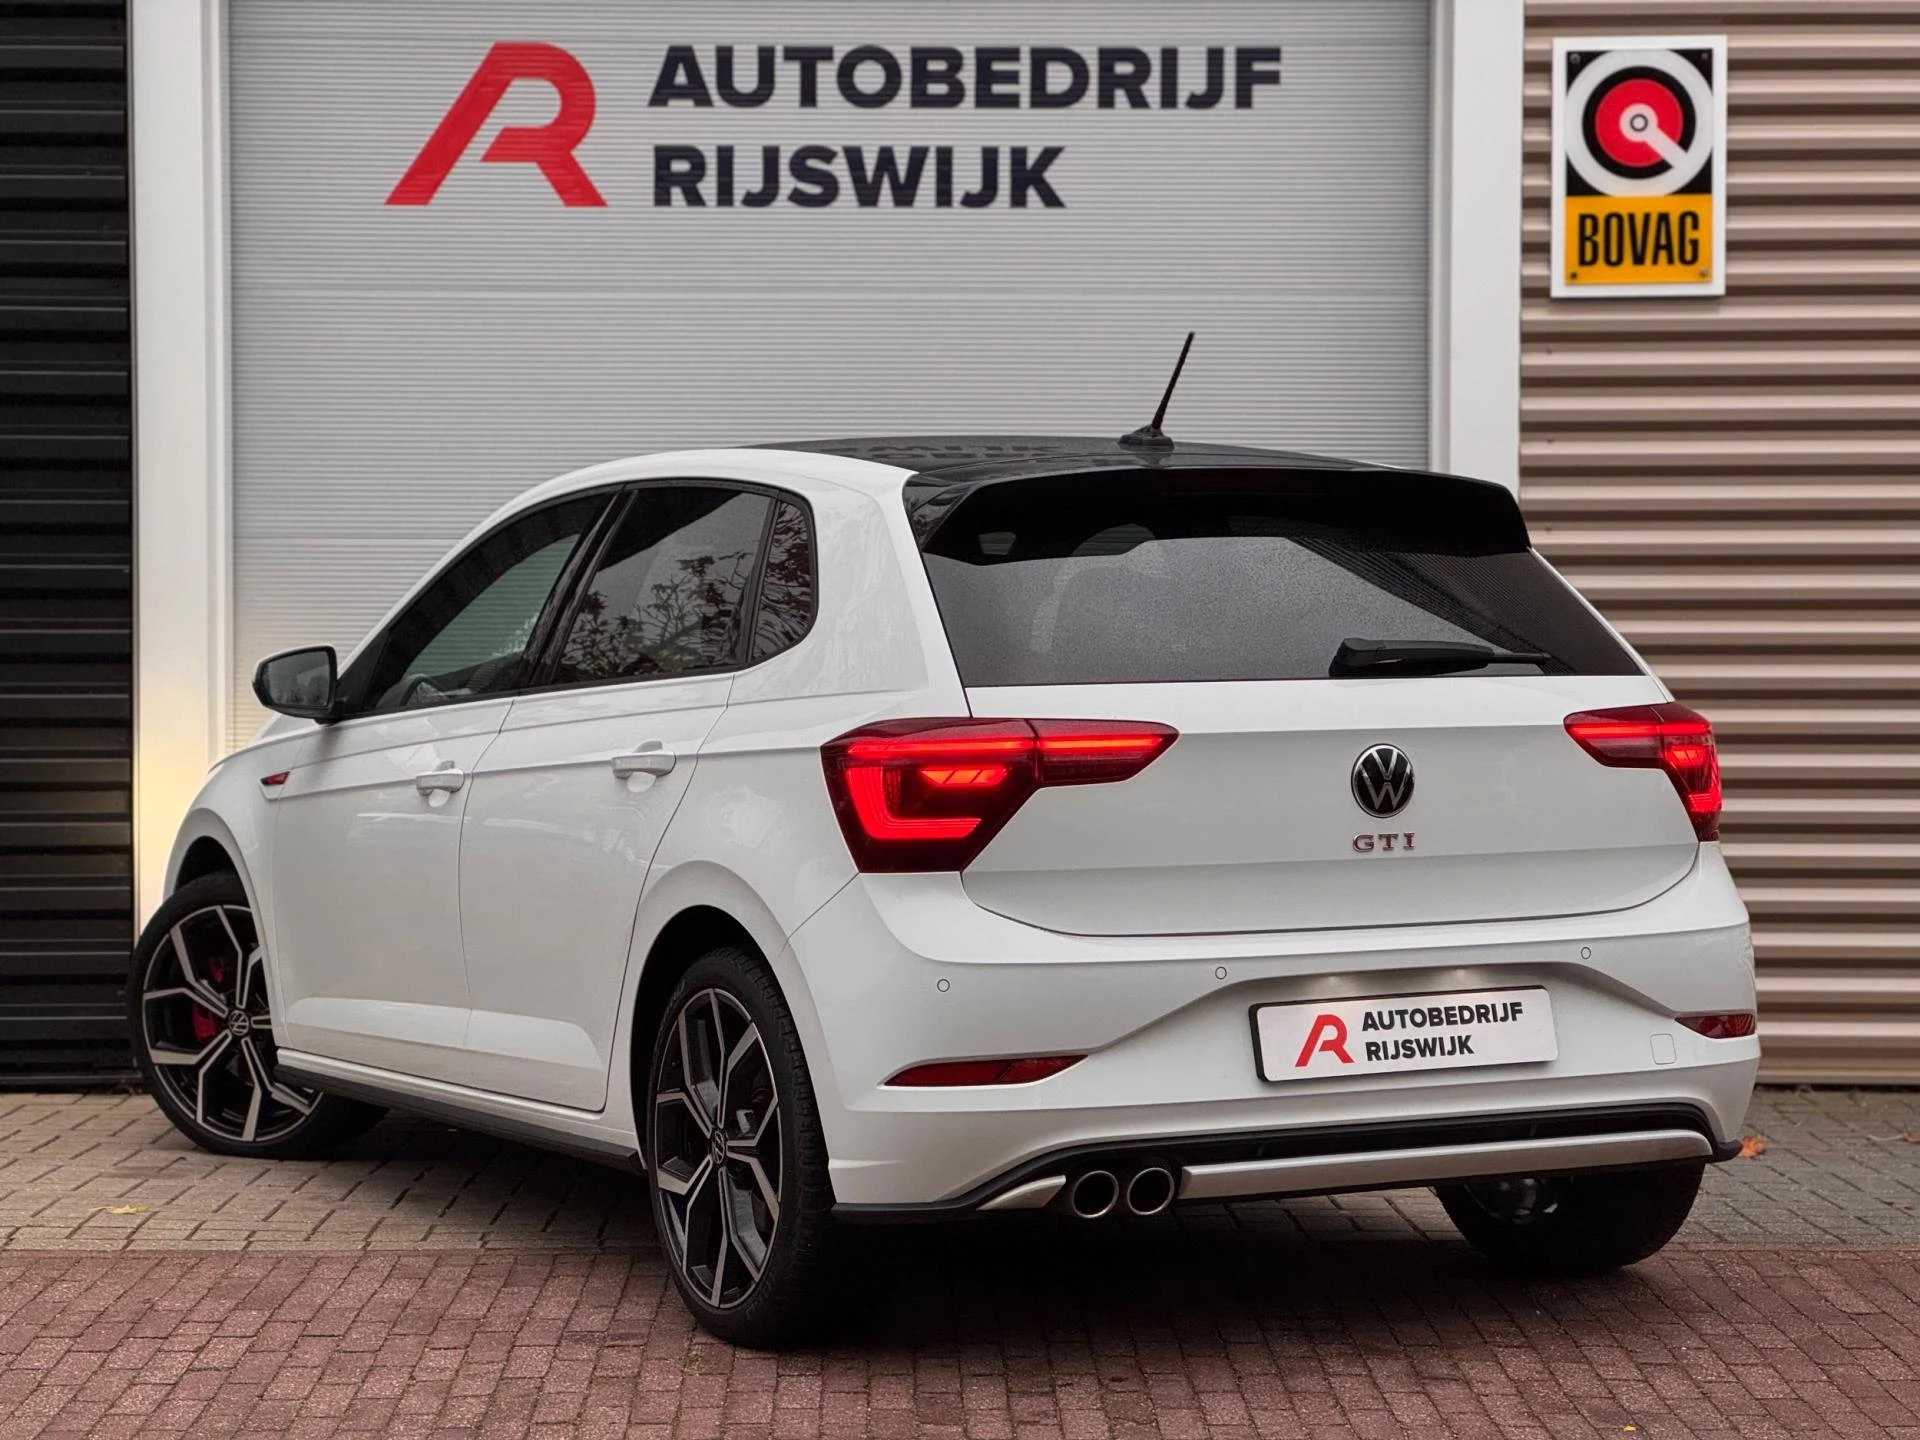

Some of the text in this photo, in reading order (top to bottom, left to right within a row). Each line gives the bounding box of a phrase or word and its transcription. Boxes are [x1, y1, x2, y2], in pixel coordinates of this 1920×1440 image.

[648, 44, 1281, 109] AUTOBEDRIJF
[652, 144, 1067, 208] RIJSWIJK
[1578, 211, 1699, 267] BOVAG
[1353, 833, 1415, 852] GTI
[1362, 1002, 1523, 1031] AUTOBEDRIJF
[1366, 1035, 1475, 1061] RIJSWIJK
